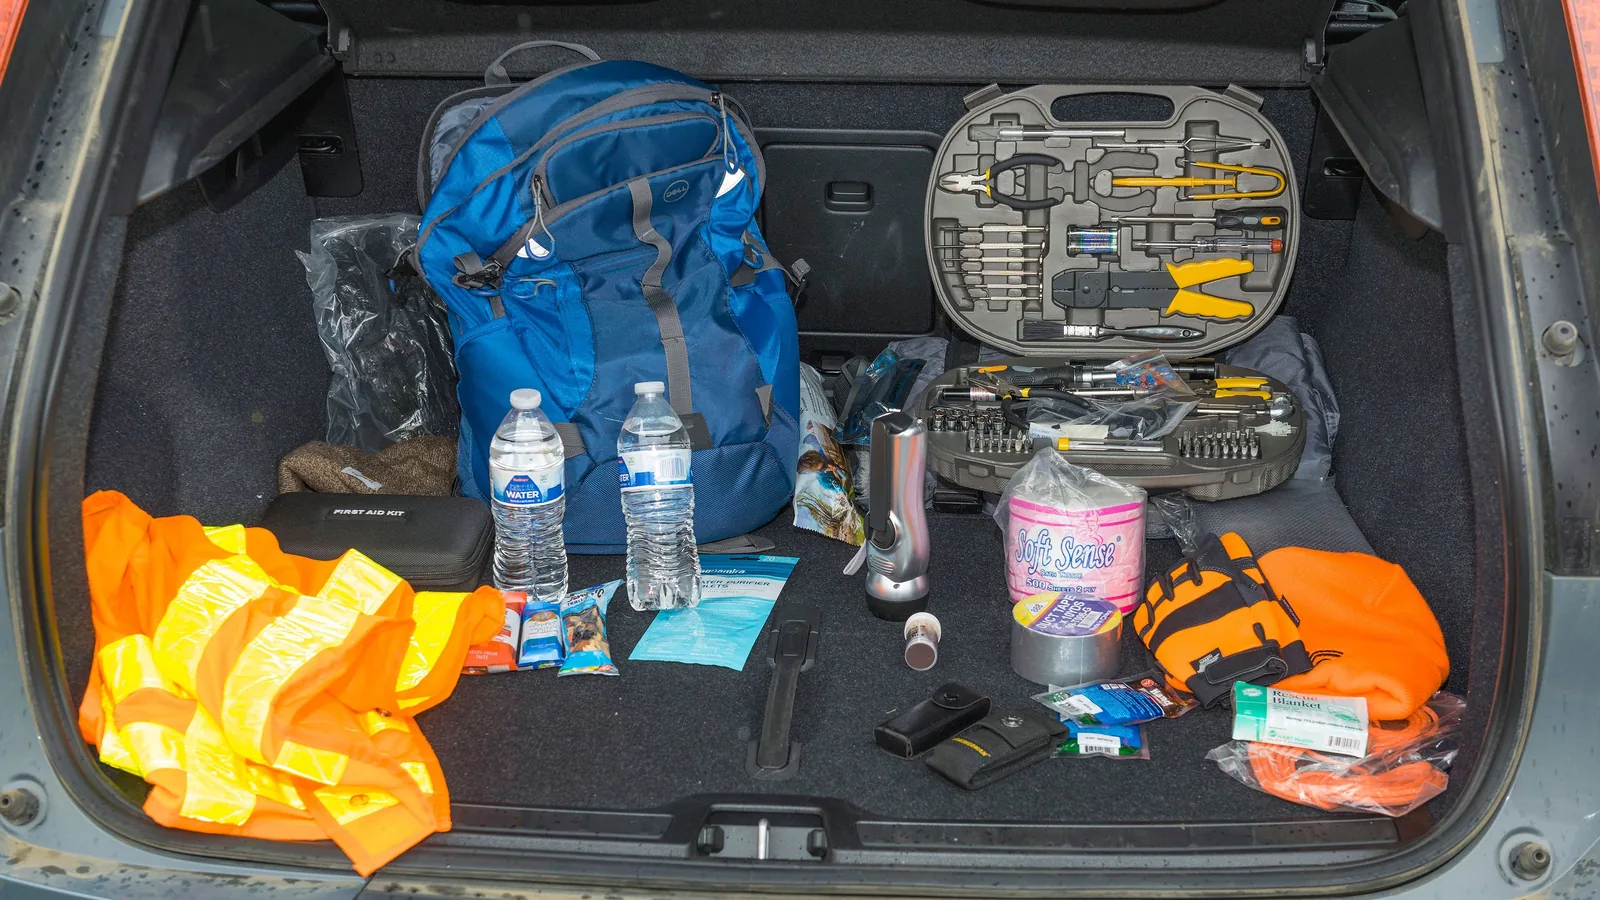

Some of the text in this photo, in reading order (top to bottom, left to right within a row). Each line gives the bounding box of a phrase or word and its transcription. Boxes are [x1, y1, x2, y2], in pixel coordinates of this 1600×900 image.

[506, 490, 540, 499] WATER
[1015, 528, 1115, 575] Soft Sense
[1025, 577, 1047, 590] 500
[1076, 585, 1083, 593] 2
[1035, 612, 1059, 630] DUCT
[1053, 594, 1077, 616] TAPE
[1065, 601, 1085, 620] 10YDS
[1149, 687, 1175, 707] Hand
[1273, 690, 1319, 701] Rescue
[1273, 697, 1322, 710] Blanket
